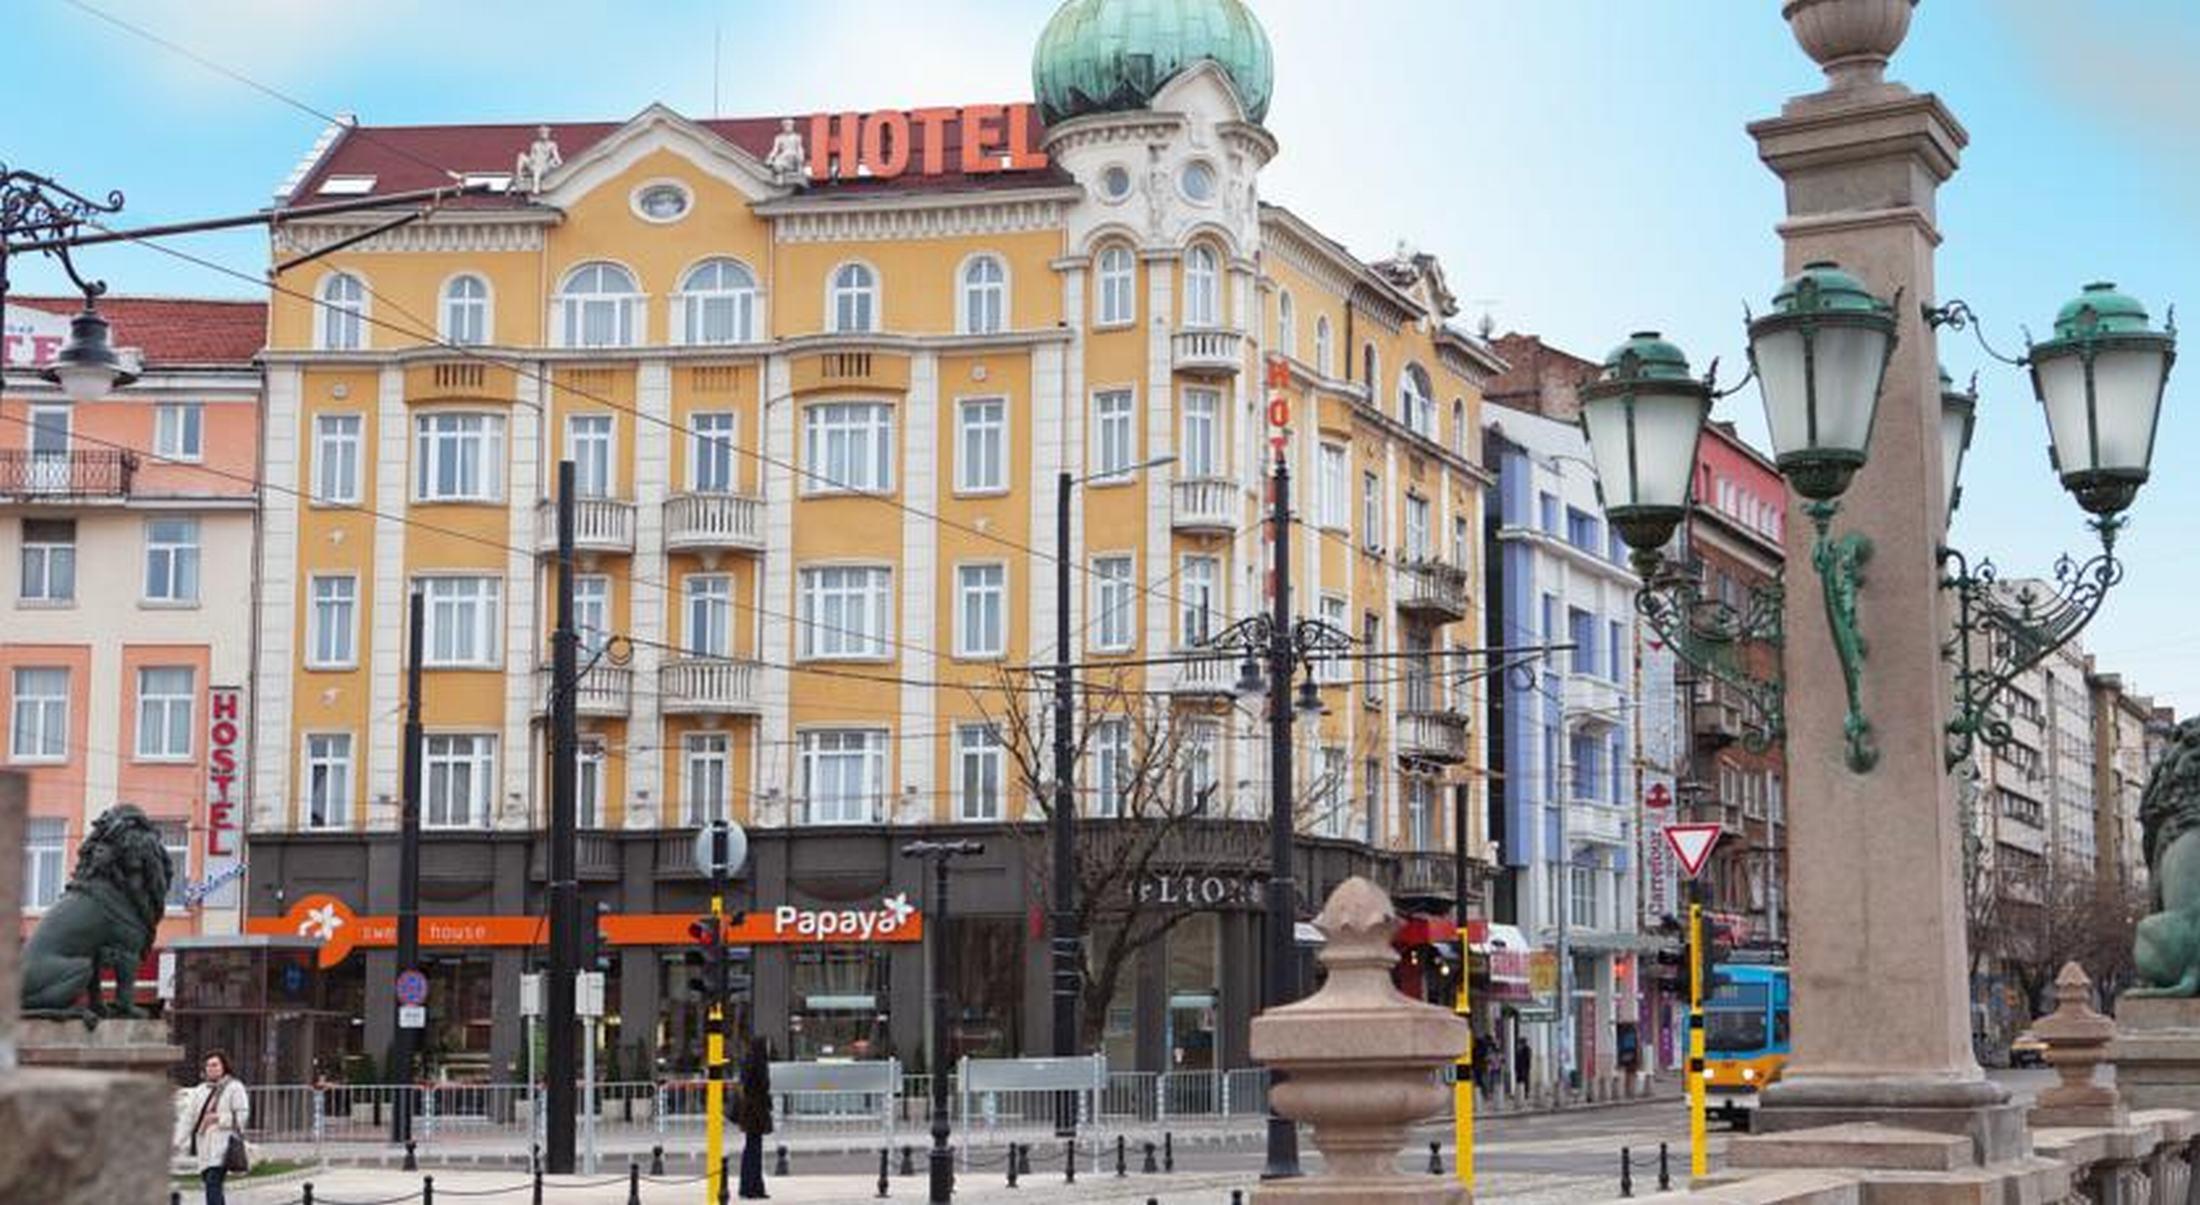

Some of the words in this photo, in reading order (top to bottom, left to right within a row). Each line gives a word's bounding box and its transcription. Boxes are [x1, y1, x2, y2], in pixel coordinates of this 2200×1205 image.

[811, 102, 1048, 181] HOTEL
[208, 693, 238, 856] HOSTEL
[429, 924, 487, 940] house
[775, 905, 896, 941] Papaya
